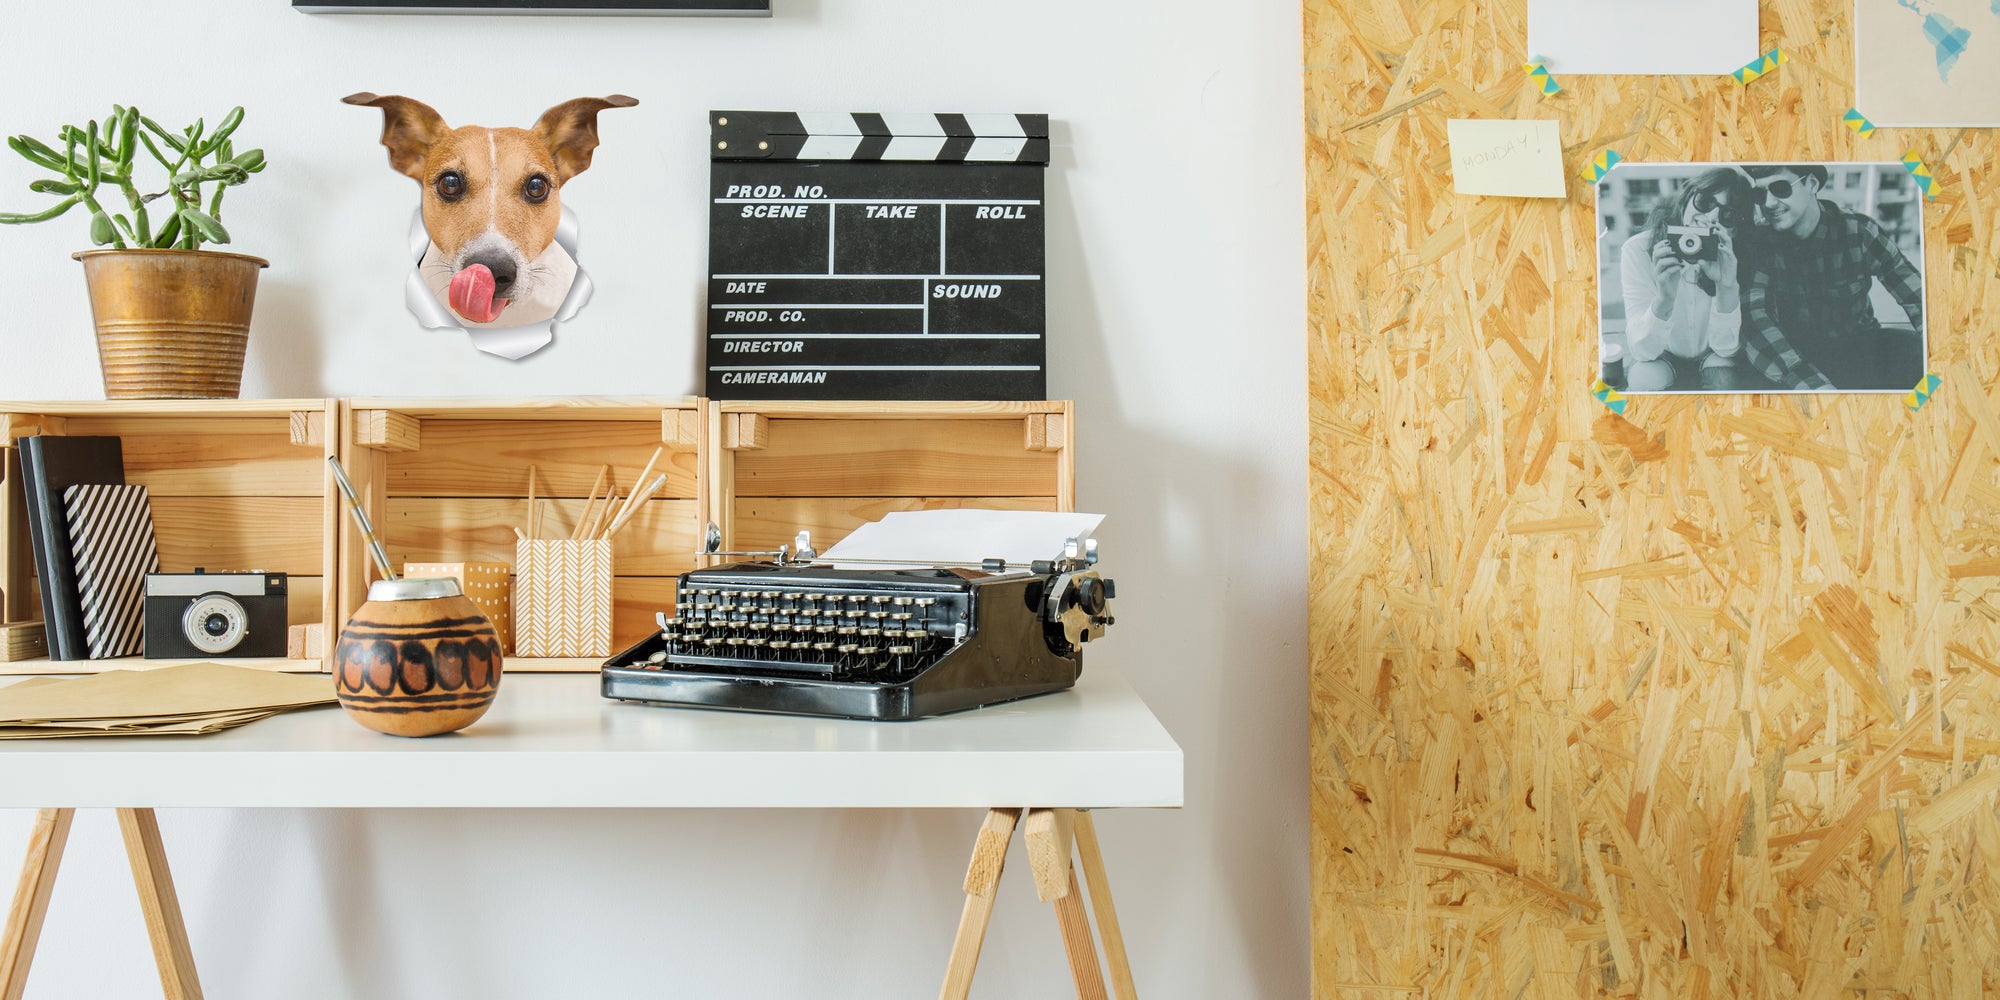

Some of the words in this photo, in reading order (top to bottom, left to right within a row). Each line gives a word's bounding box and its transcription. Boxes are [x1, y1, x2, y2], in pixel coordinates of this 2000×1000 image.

[726, 185, 786, 198] PROD.
[794, 186, 828, 198] NO.
[741, 205, 808, 218] SCENE
[866, 206, 918, 219] TAKE
[976, 206, 1026, 219] ROLL
[726, 282, 766, 294] DATE
[933, 285, 1001, 299] SOUND
[725, 311, 773, 323] PROD.
[780, 311, 806, 323] CO.
[724, 341, 804, 353] DIRECTOR
[722, 372, 827, 384] CAMERAMAN
